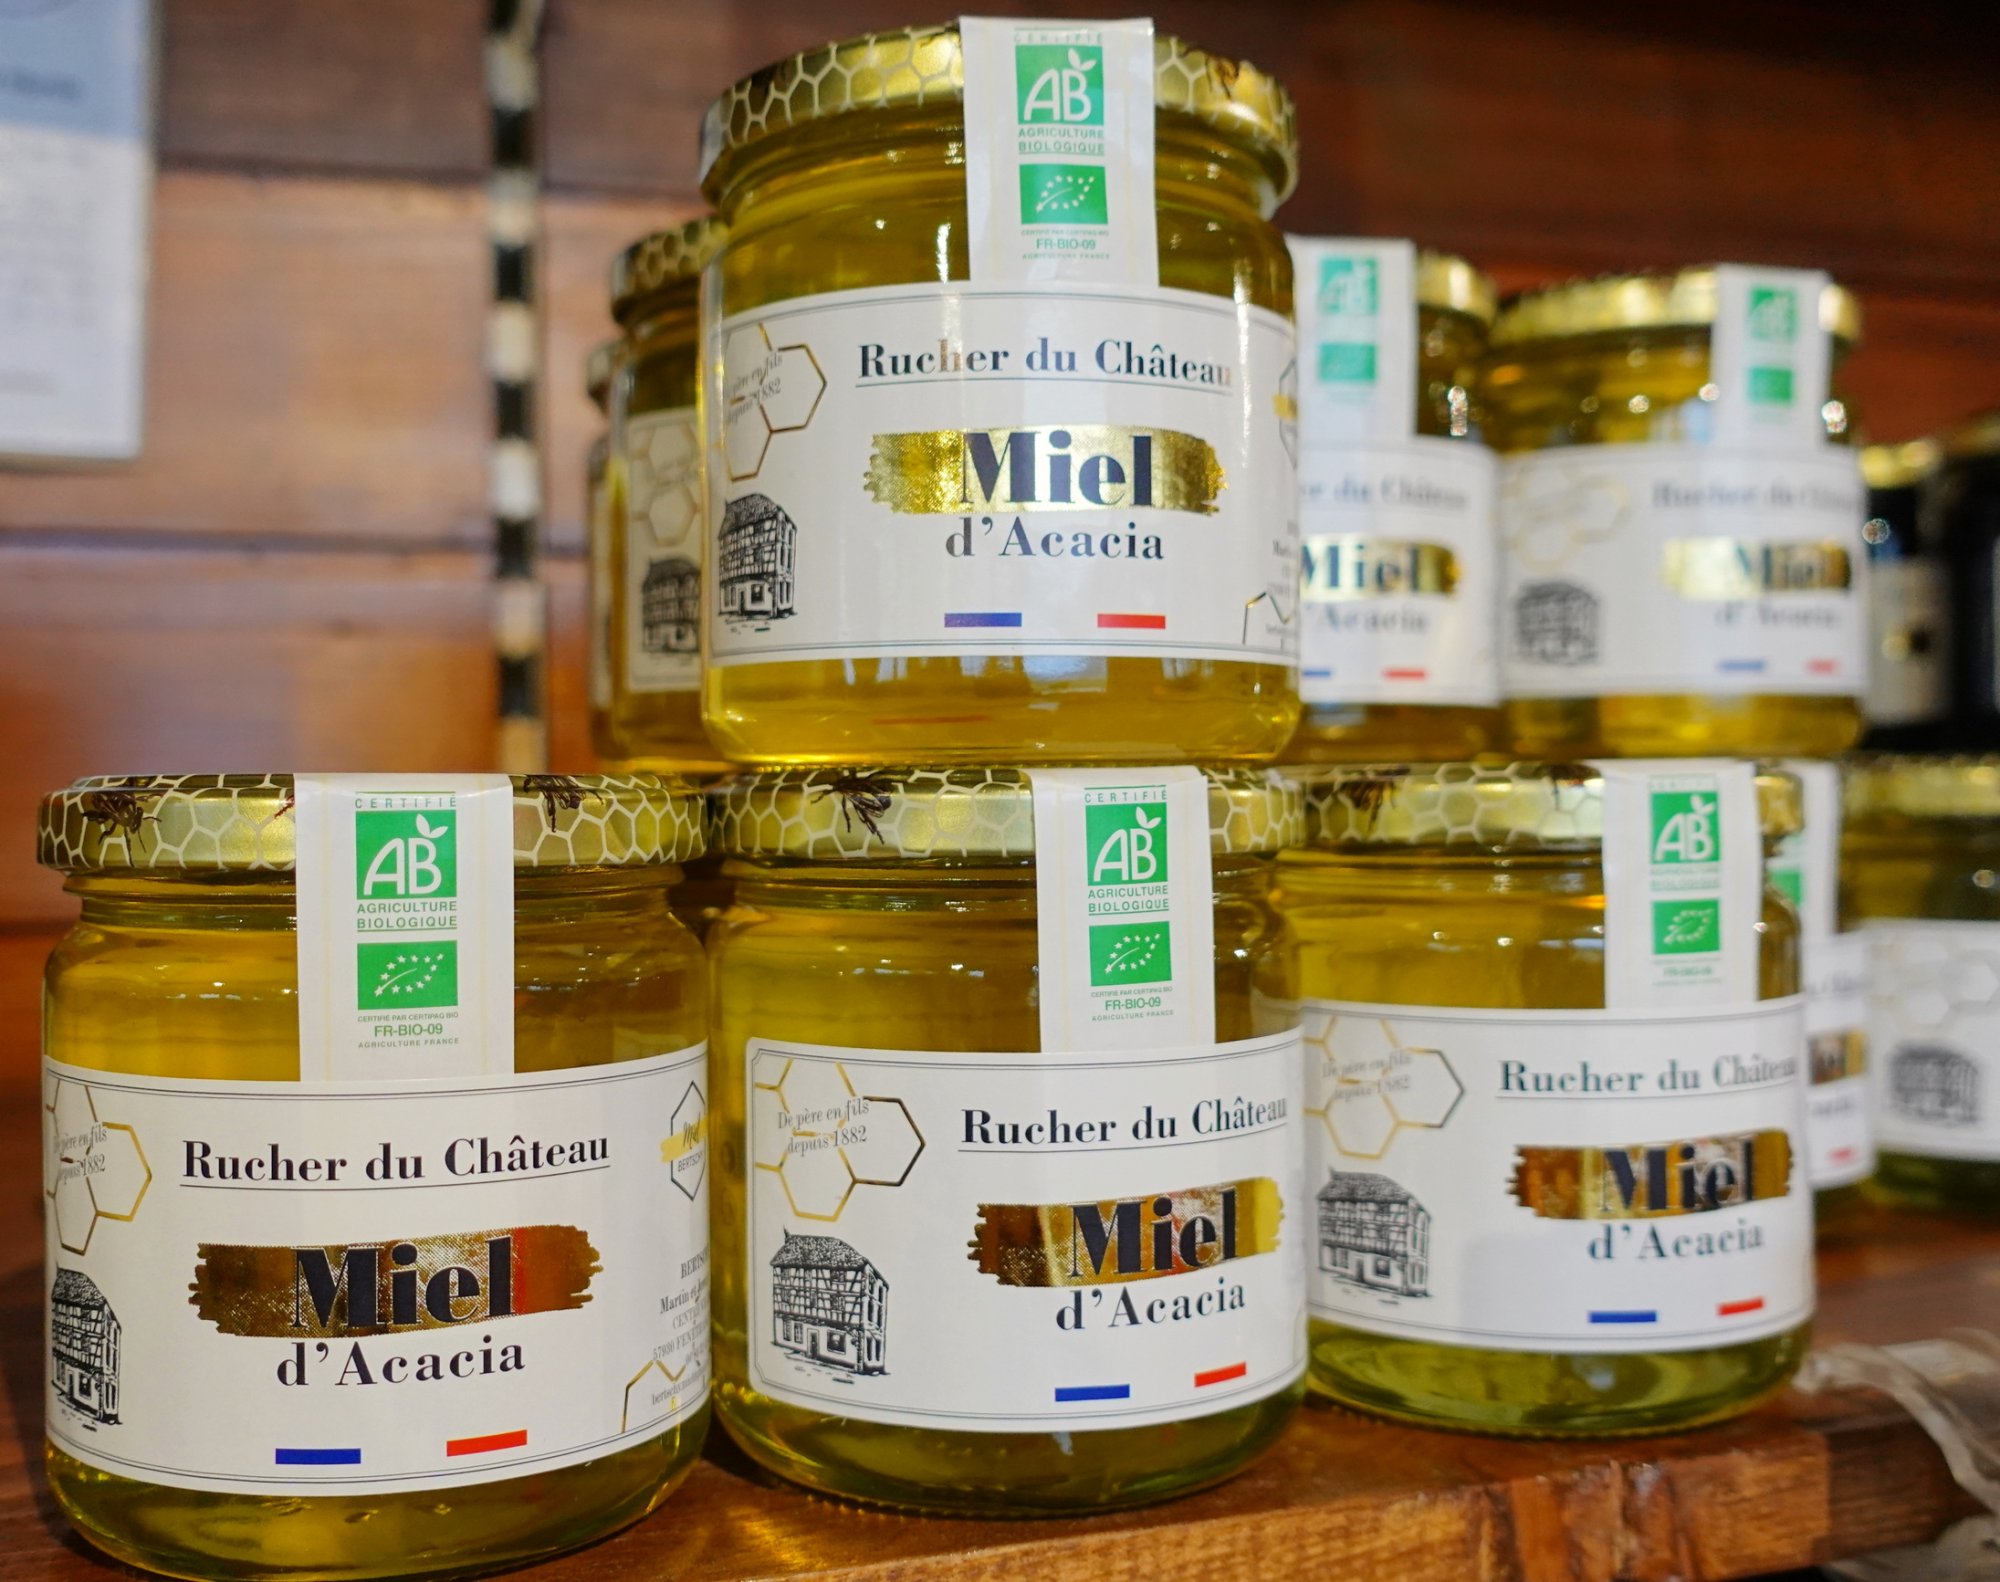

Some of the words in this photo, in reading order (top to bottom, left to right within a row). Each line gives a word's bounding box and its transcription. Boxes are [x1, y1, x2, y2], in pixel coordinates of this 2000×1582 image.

[1024, 68, 1092, 121] AB
[1018, 127, 1105, 139] AGRICULTURE
[1018, 140, 1105, 154] BIOLOGIQUE
[1036, 238, 1096, 250] FR-BIO-09
[858, 338, 1009, 379] Rucher
[1026, 337, 1079, 372] du
[1095, 339, 1232, 386] Château
[960, 429, 1155, 508] Miel
[945, 516, 1165, 560] d'Acacia
[355, 795, 457, 809] CERTIFIÉ
[1084, 790, 1168, 803] CERTIFIÉ
[1655, 812, 1714, 860] AB
[364, 838, 442, 896] AB
[1093, 828, 1158, 882] AB
[357, 901, 457, 914] AGRICULTURE
[1088, 885, 1169, 899] AGRICULTURE
[1088, 898, 1169, 913] BIOLOGIQUE
[357, 916, 457, 929] BIOLOGIQUE
[1092, 1011, 1144, 1021] AGRICULTURE
[1105, 996, 1161, 1011] FR-BIO-09
[358, 1040, 421, 1048] AGRICULTURE
[374, 1023, 443, 1037] FR-BIO-09
[1498, 1060, 1644, 1093] Rucher
[1657, 1059, 1701, 1090] du
[778, 1111, 794, 1129] De
[795, 1107, 823, 1130] père
[826, 1106, 842, 1120] en
[846, 1097, 870, 1122] fils
[961, 1109, 1117, 1145] Rucher
[1132, 1105, 1178, 1141] du
[1192, 1096, 1288, 1135] Château
[787, 1137, 829, 1157] depuis
[833, 1124, 868, 1147] 1882
[83, 1153, 106, 1177] 1882
[183, 1140, 347, 1182] Rucher
[365, 1142, 425, 1181] du
[444, 1134, 609, 1177] Château
[1599, 1139, 1753, 1211] Miel
[1068, 1187, 1238, 1278] Miel
[1587, 1217, 1764, 1261] d'Acacia
[289, 1236, 515, 1328] Miel
[660, 1289, 690, 1314] Martin
[1056, 1276, 1245, 1331] d'Acacia
[277, 1334, 526, 1387] d'Acacia
